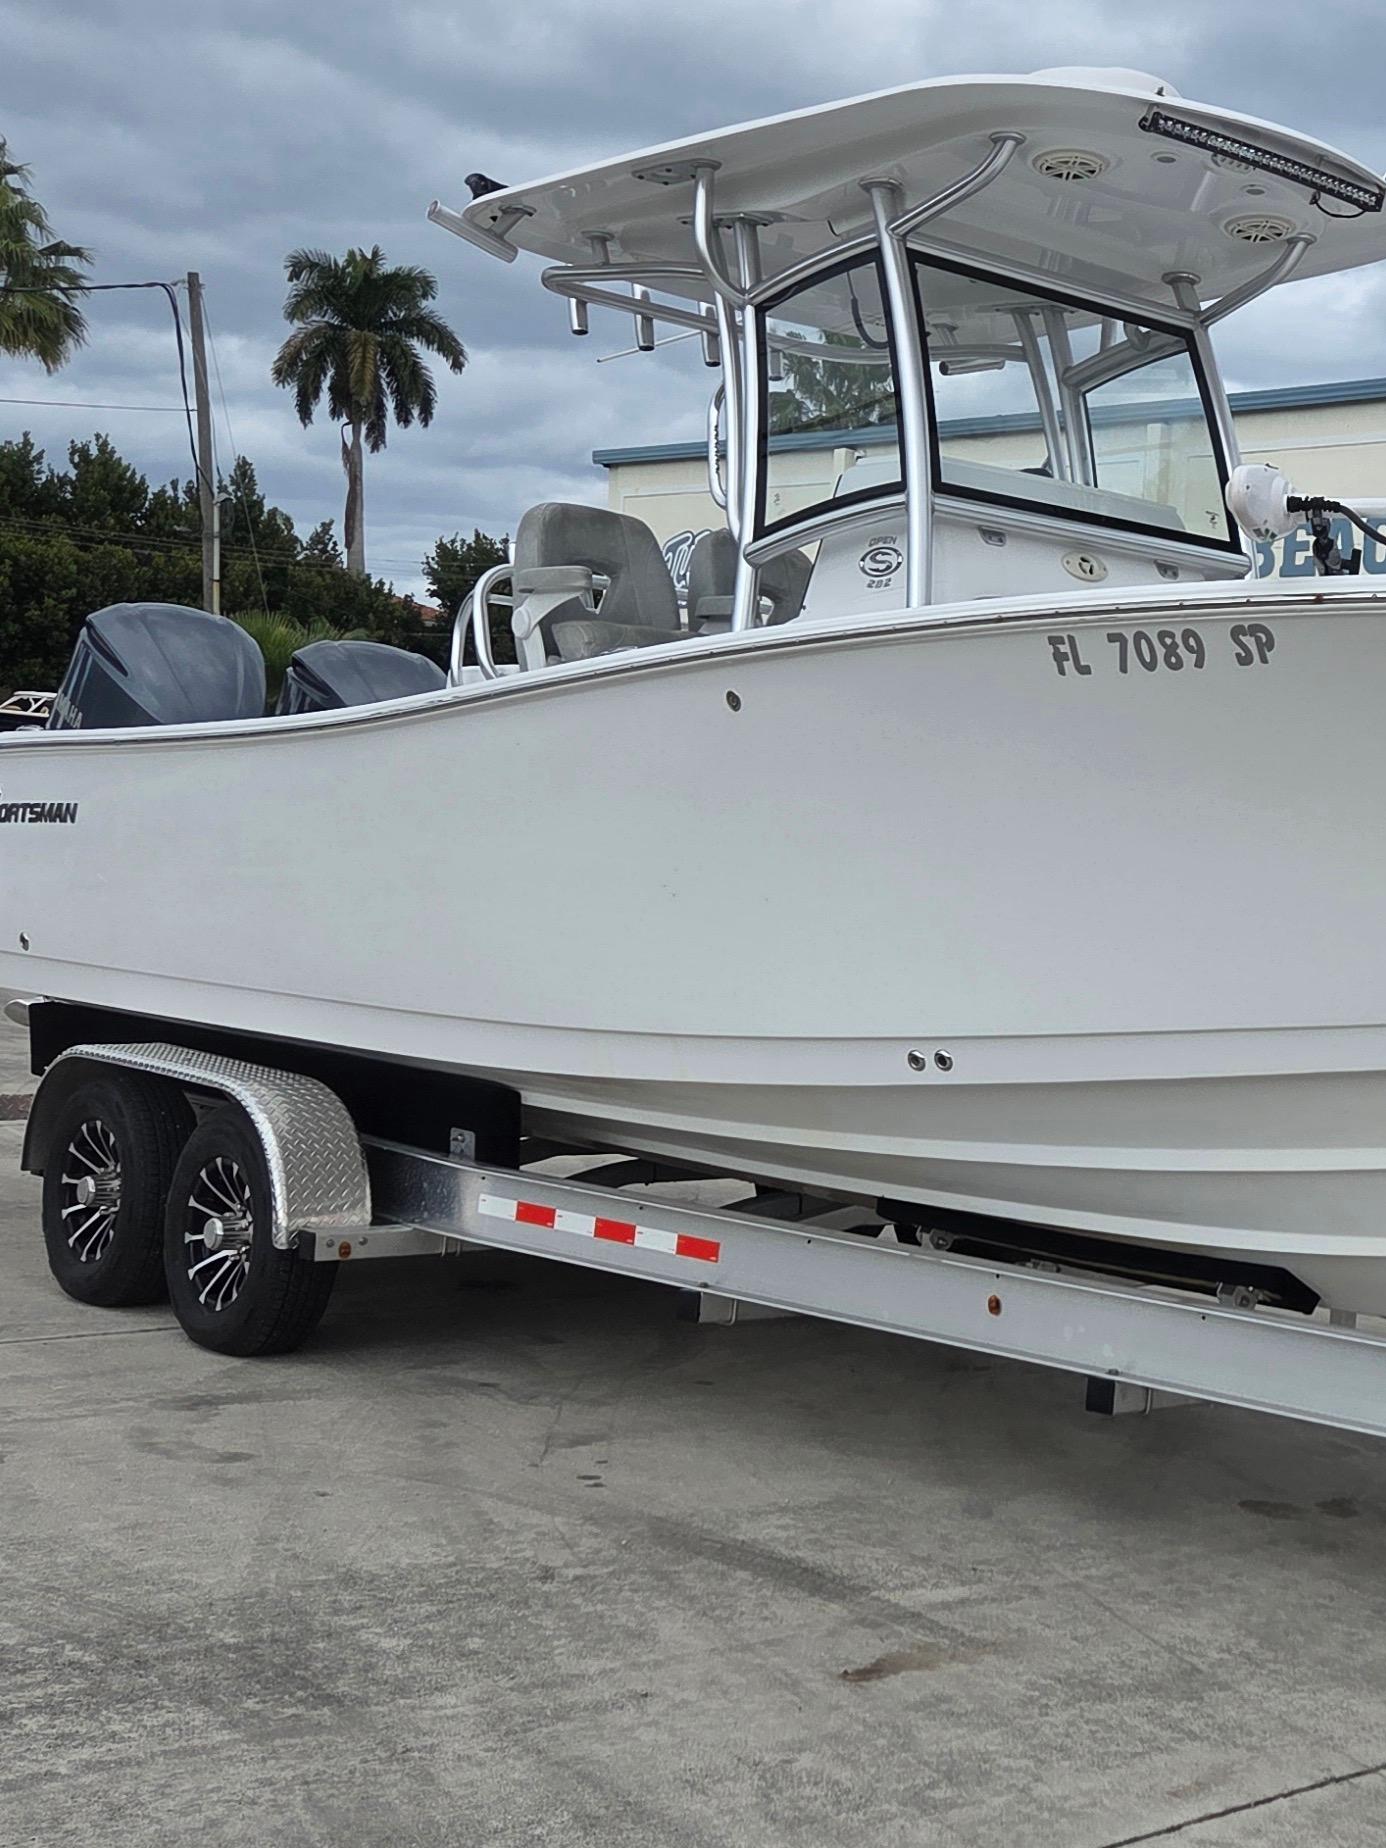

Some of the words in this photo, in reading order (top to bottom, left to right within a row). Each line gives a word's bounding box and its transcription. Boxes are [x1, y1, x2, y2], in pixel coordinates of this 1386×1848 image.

[1047, 633, 1092, 676] FL
[1106, 628, 1206, 674] 7089
[1229, 623, 1275, 666] SP
